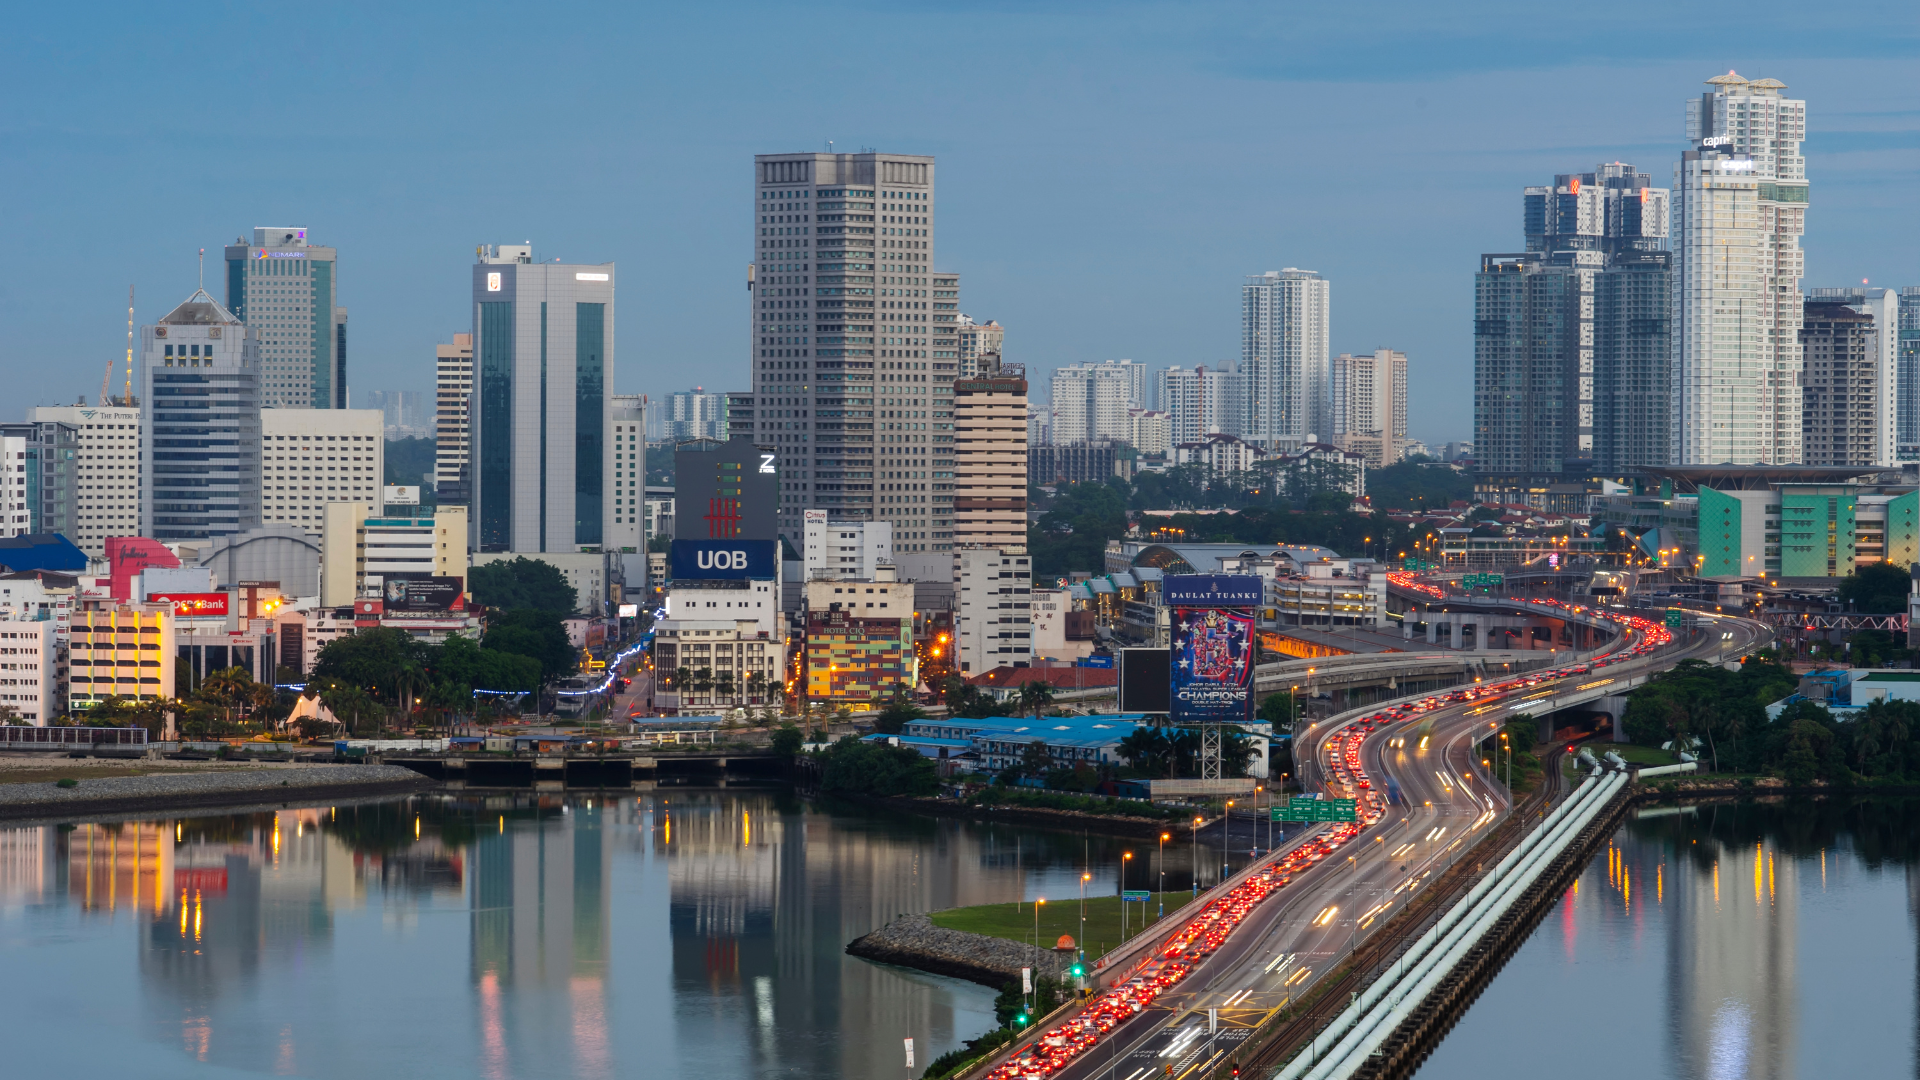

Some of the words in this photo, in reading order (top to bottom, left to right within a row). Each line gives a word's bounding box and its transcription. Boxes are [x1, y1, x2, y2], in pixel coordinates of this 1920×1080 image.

[1703, 134, 1726, 148] capri
[120, 544, 148, 566] Galleria
[698, 550, 748, 569] UOB
[202, 600, 224, 609] Bank
[1178, 692, 1247, 700] CHAMPIONS
